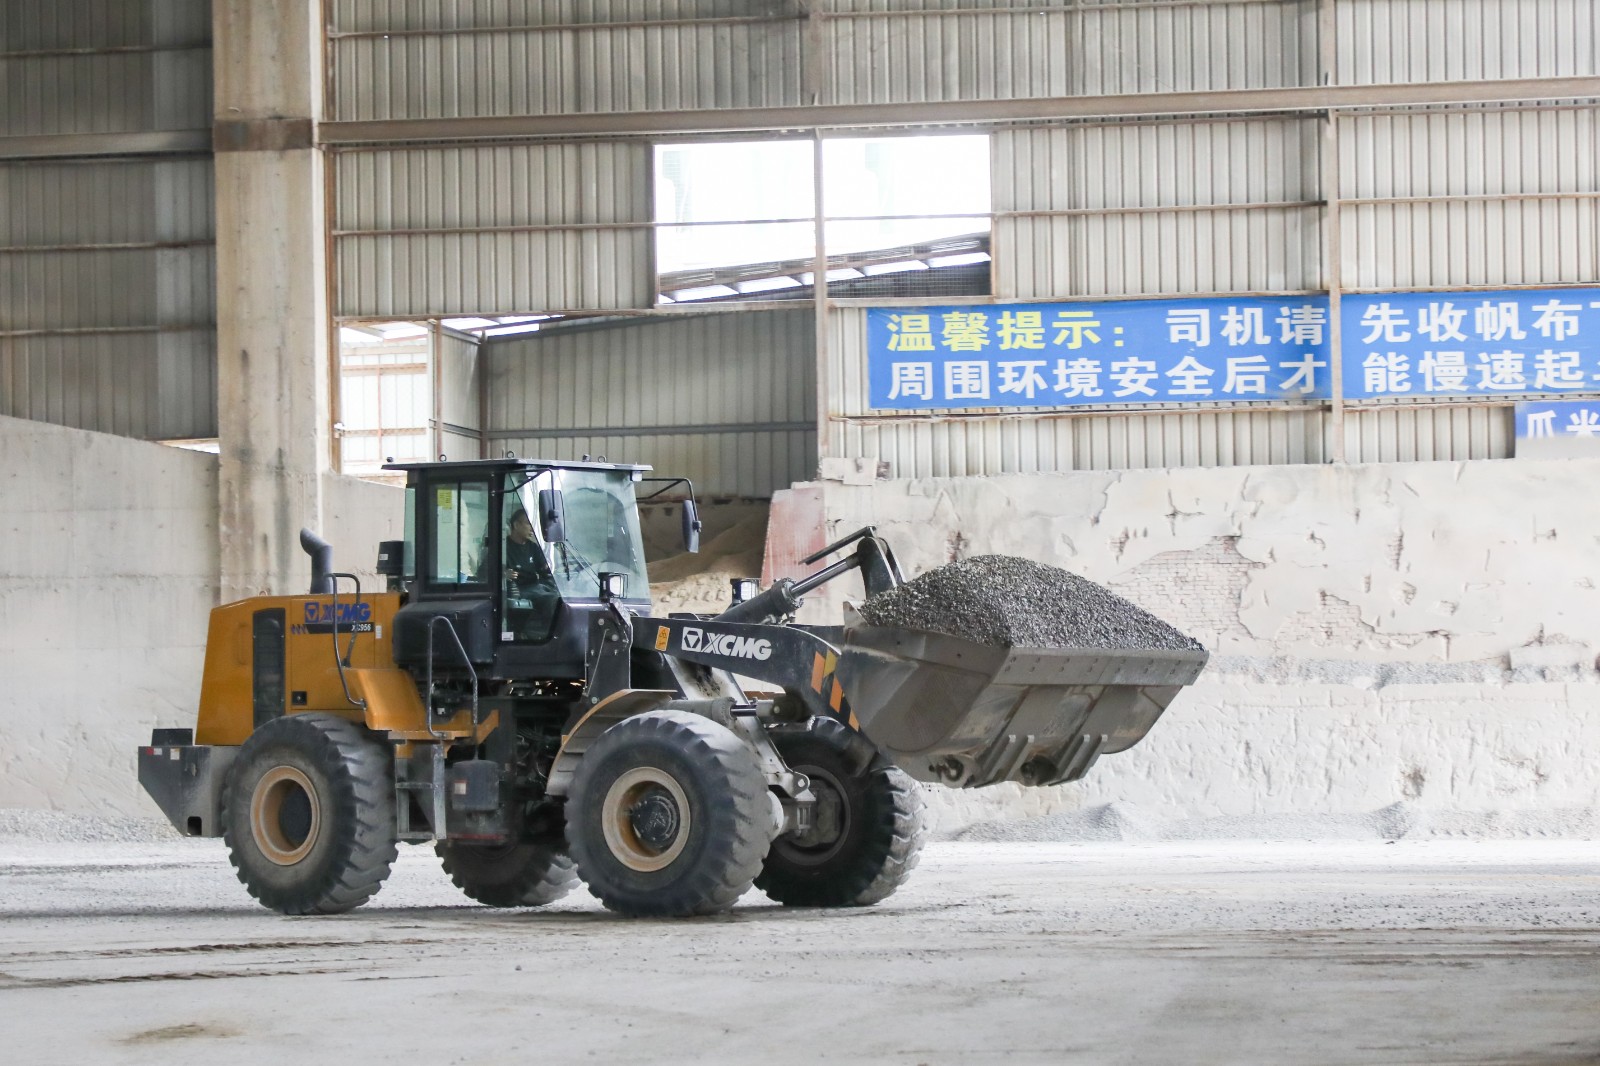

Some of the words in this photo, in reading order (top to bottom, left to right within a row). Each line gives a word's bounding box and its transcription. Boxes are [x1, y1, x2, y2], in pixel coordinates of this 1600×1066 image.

[886, 310, 1125, 352] 温馨提示：
[1165, 305, 1327, 347] 司机请
[1360, 299, 1600, 345] 先收帆布
[887, 354, 1327, 400] 周围环境安全后才
[1362, 349, 1600, 393] 能慢速起
[700, 632, 772, 660] XCMG
